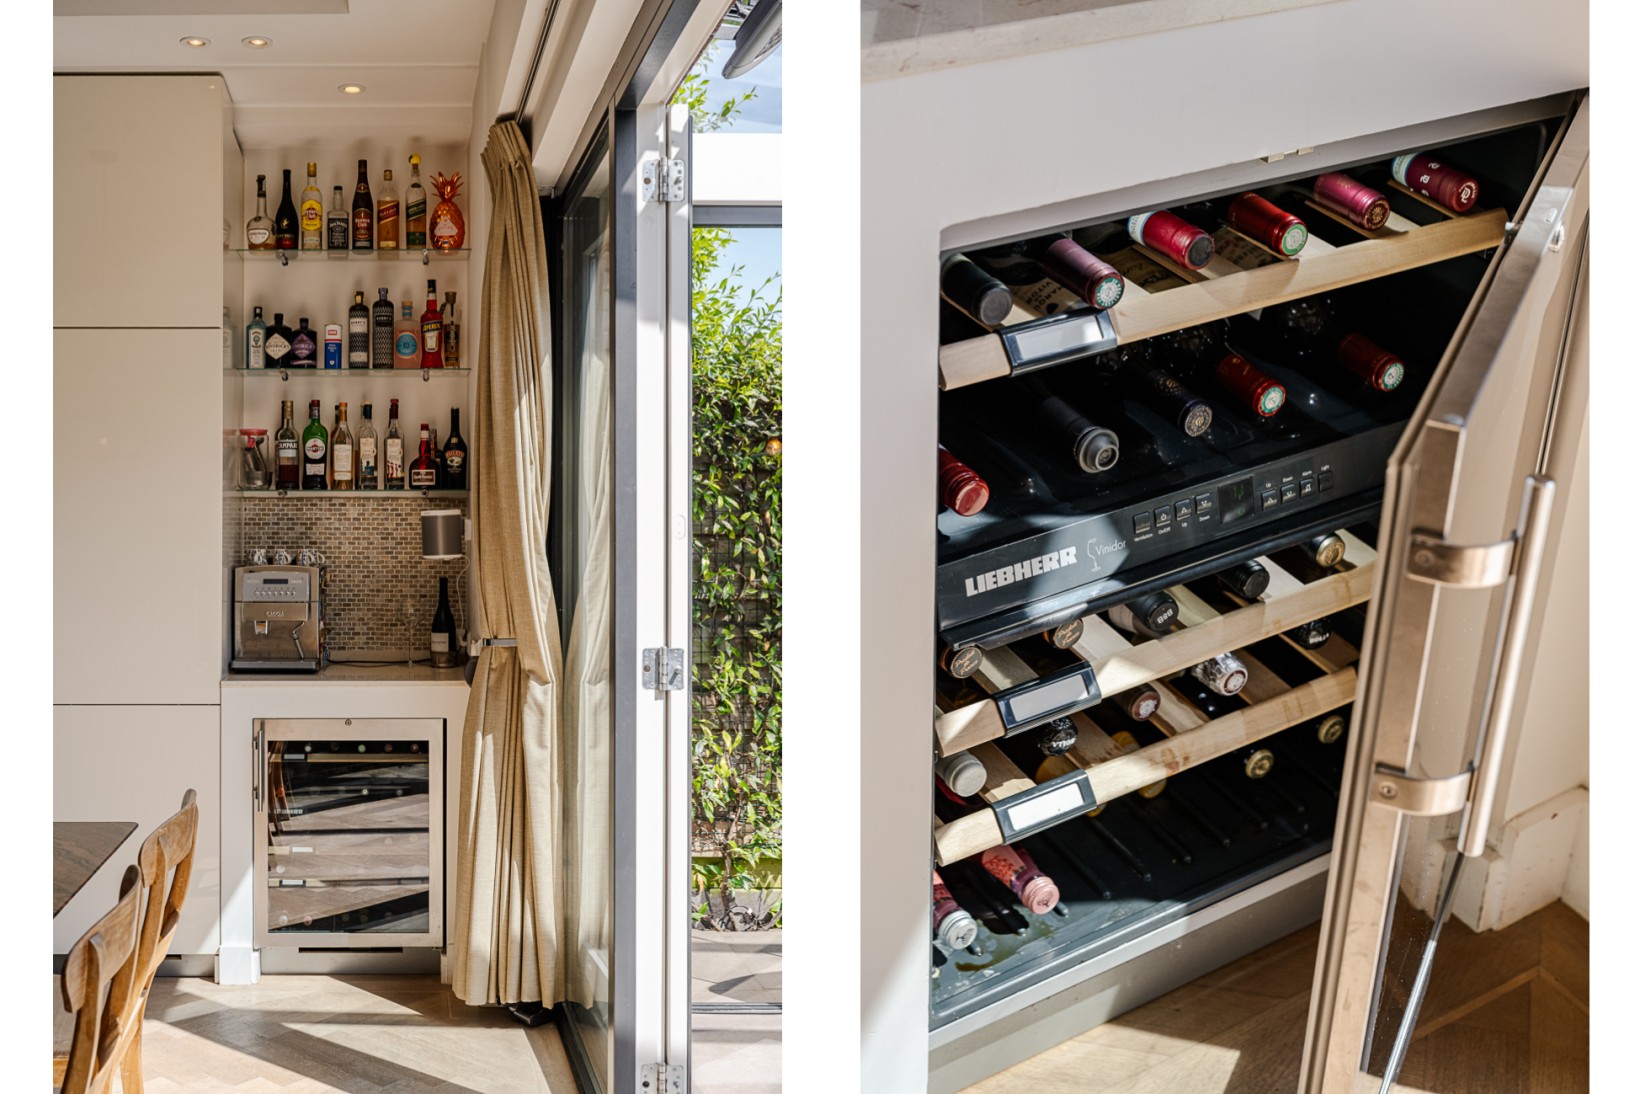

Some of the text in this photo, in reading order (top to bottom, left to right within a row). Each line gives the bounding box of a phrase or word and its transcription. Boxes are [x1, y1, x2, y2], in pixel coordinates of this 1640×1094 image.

[422, 323, 441, 332] APEROL
[1320, 464, 1330, 472] Light
[1199, 515, 1211, 523] Down
[1158, 527, 1171, 535] On/Off
[1133, 533, 1154, 542] Ventilation
[1095, 539, 1127, 556] Vinidor
[964, 546, 1078, 598] LIEBHERR
